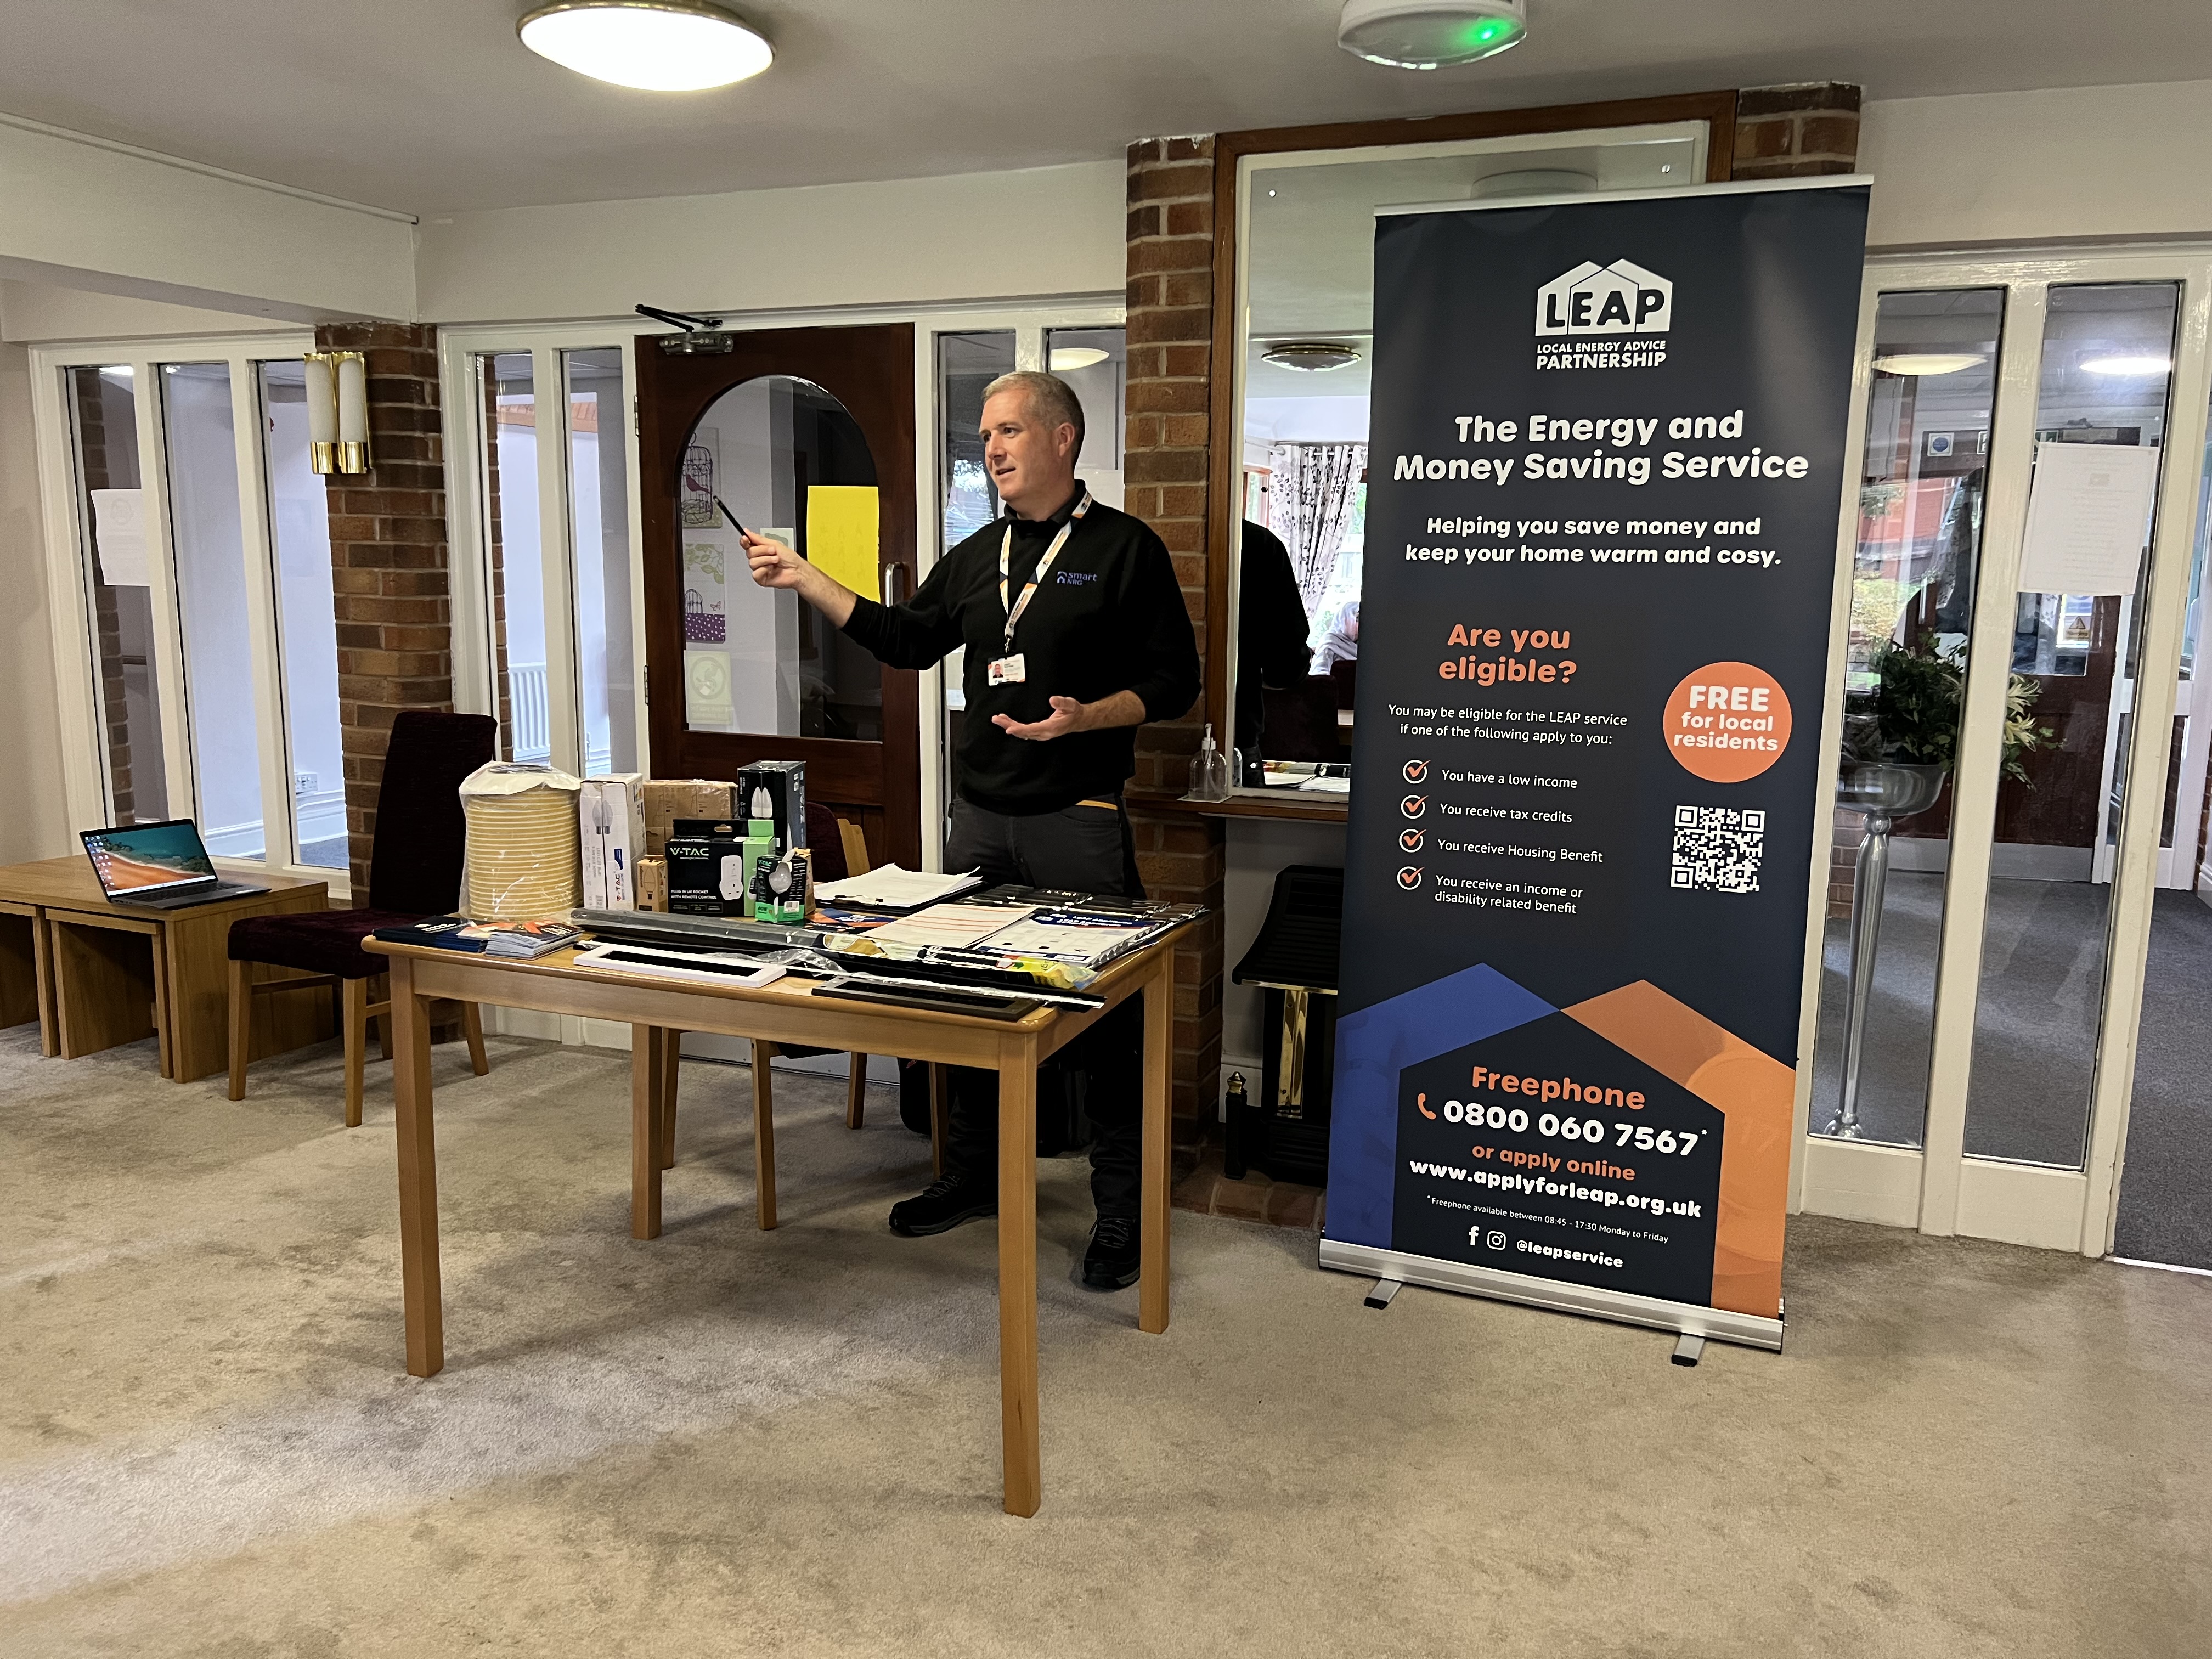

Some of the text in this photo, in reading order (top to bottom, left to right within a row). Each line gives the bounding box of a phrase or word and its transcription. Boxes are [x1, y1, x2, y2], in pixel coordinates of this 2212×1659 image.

[1544, 289, 1665, 328] LEAP
[1537, 341, 1666, 353] LOCAL ENERGY ADVICE
[1537, 352, 1666, 369] PARTNERSHIP
[1455, 410, 1743, 447] The Energy and
[1394, 448, 1808, 485] Money Saving Service
[1427, 516, 1760, 538] Helping you save money and
[1406, 544, 1781, 568] keep your home warm and cosy.
[1068, 572, 1097, 582] smart
[1448, 624, 1570, 652] Are you
[1439, 656, 1576, 686] eligible?
[1690, 686, 1769, 712] FREE
[1389, 704, 1627, 725] You may be eligible for the LEAP service
[1681, 712, 1773, 731] for local
[1401, 724, 1612, 746] if one of the following apply to you:
[1674, 731, 1778, 751] residents
[1442, 770, 1463, 781] You
[1468, 771, 1494, 783] have
[1509, 774, 1530, 785] low
[1534, 775, 1577, 788] income
[1440, 804, 1572, 822] You receive tax credits
[670, 848, 709, 856] V-TAC
[1438, 839, 1602, 862] You receive Housing Benefit
[1436, 875, 1457, 887] You
[1462, 879, 1502, 890] receive
[1505, 884, 1519, 892] an
[1524, 883, 1566, 896] income
[1435, 891, 1576, 913] disability related benefit
[1472, 1066, 1645, 1109] Freephone
[1444, 1101, 1528, 1132] 0800
[1539, 1114, 1604, 1143] 060
[1472, 1146, 1635, 1180] or apply online
[1409, 1160, 1702, 1218] www.applyforleap.org.uk
[1473, 1206, 1507, 1216] available
[1510, 1210, 1542, 1222] between
[1545, 1216, 1566, 1226] 08:45
[1576, 1221, 1596, 1231] 17:30
[1599, 1225, 1630, 1238] Monday
[1644, 1232, 1668, 1243] Friday
[1517, 1240, 1623, 1267] @leapservice
